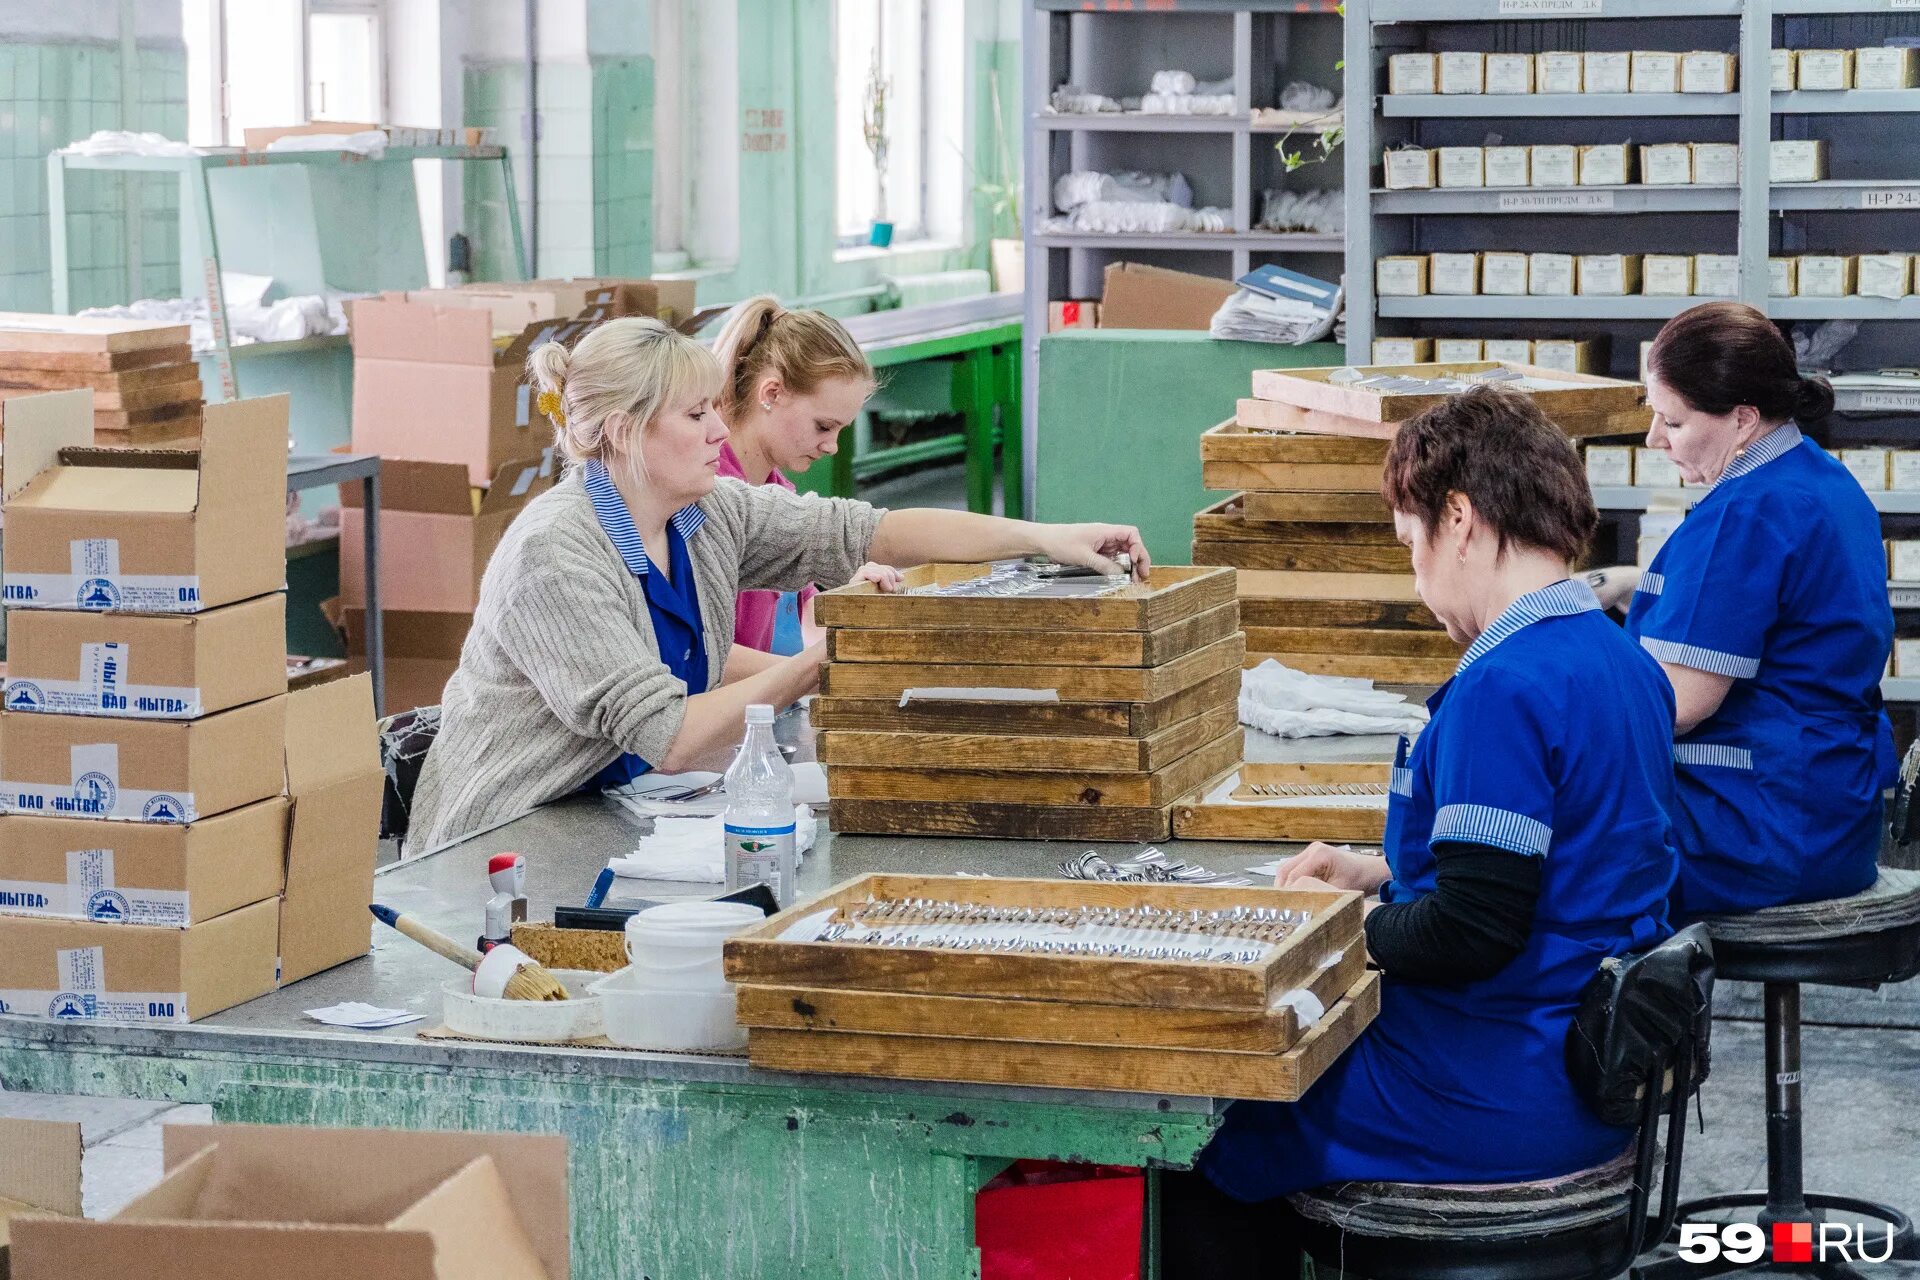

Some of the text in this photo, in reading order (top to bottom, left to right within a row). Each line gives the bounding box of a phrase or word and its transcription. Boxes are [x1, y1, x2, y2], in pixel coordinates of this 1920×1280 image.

[1868, 192, 1920, 205] Н-Р 24-
[18, 794, 44, 810] ОАО
[50, 796, 105, 813] «НЫТВА»
[149, 1002, 174, 1017] ОАО
